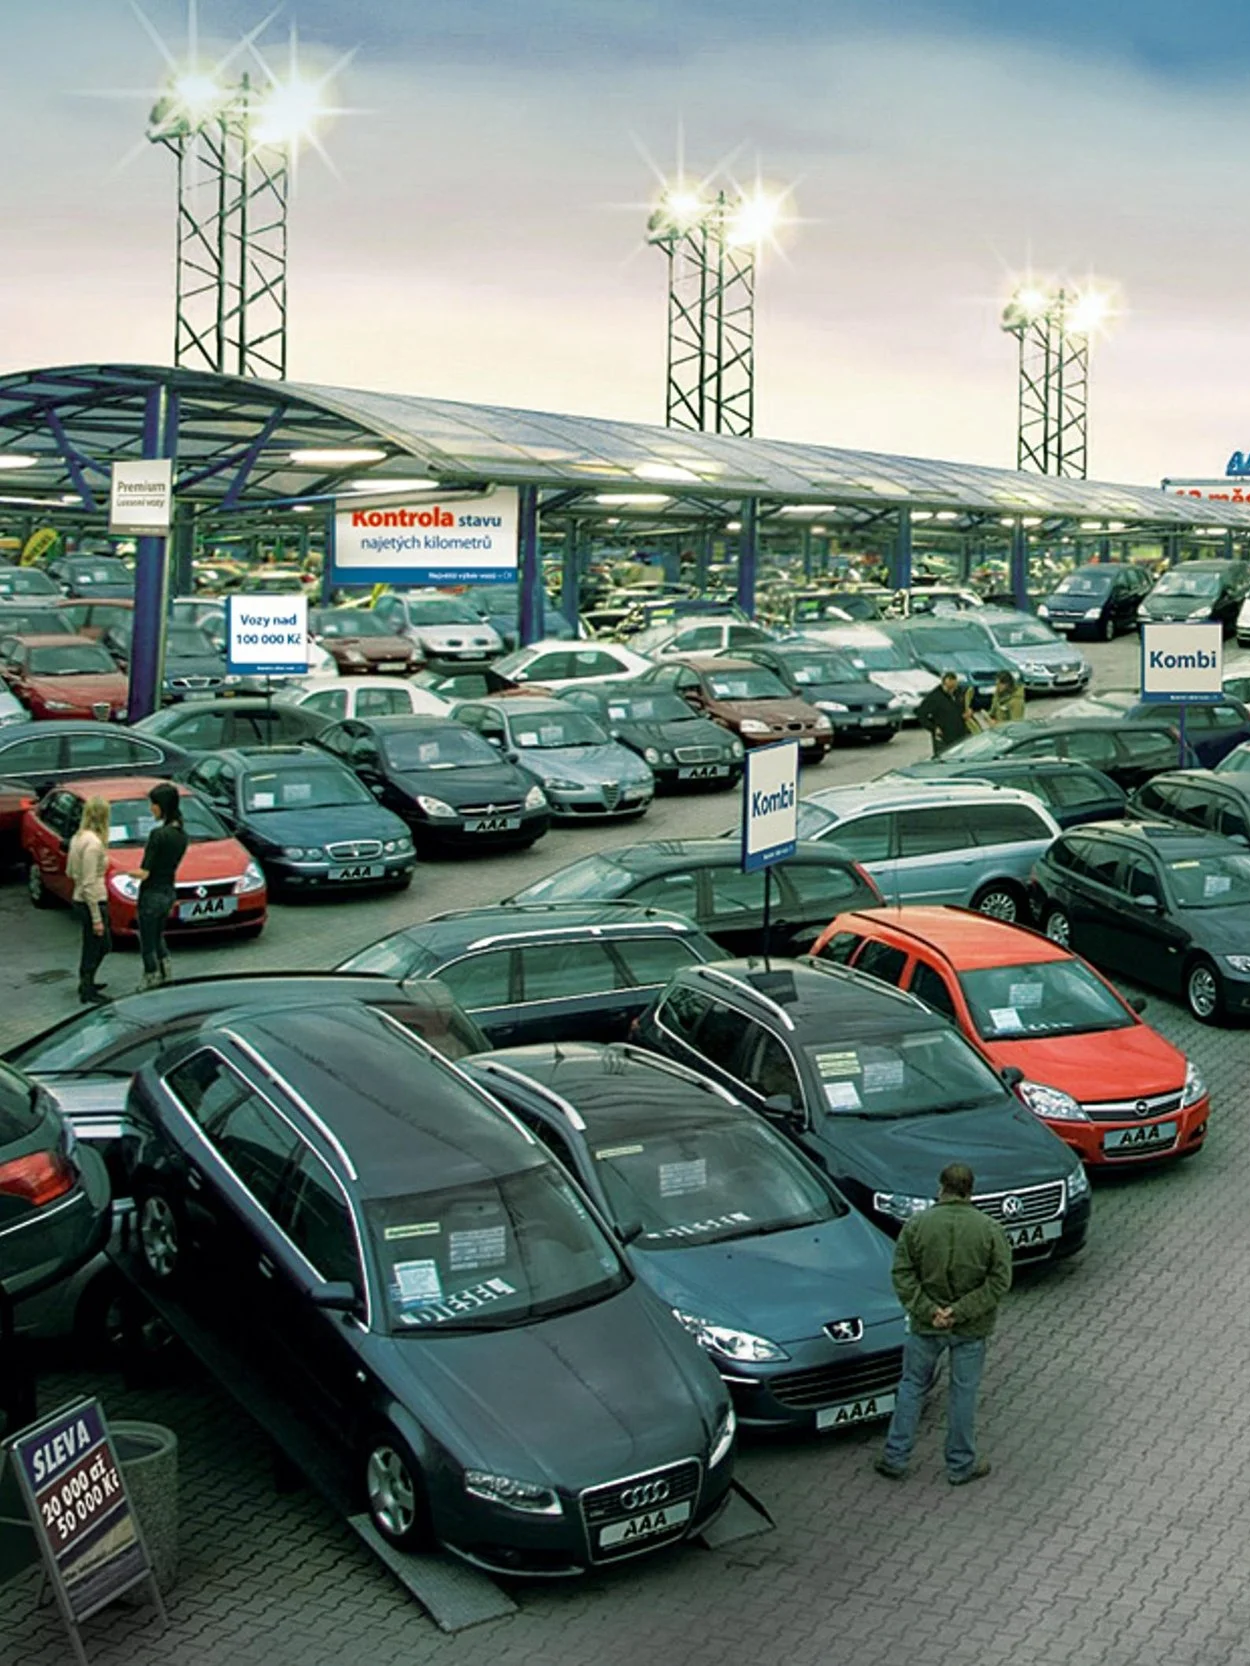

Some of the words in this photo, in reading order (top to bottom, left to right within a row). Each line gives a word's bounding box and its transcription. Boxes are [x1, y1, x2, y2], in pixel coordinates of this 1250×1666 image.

[117, 481, 166, 492] Premium
[352, 506, 455, 527] Kontrola
[458, 514, 502, 528] stavu
[361, 535, 421, 553] najetých
[424, 534, 492, 550] kilometrů
[240, 614, 270, 628] Vozy
[273, 613, 297, 626] nad
[237, 634, 258, 645] 100
[261, 634, 285, 645] 000
[287, 633, 301, 645] Kč
[1150, 649, 1217, 668] Kombi
[752, 782, 795, 818] Kombi
[477, 818, 508, 830] AAA
[340, 865, 372, 878] AAA
[191, 897, 225, 917] AAA
[1120, 1124, 1160, 1145] AAA
[835, 1397, 878, 1423] AAA
[32, 1418, 92, 1483] SLEVA
[41, 1495, 62, 1528] 20
[61, 1471, 90, 1506] 000
[56, 1510, 77, 1540] 50
[76, 1485, 104, 1521] 000
[623, 1511, 668, 1538] AAA
